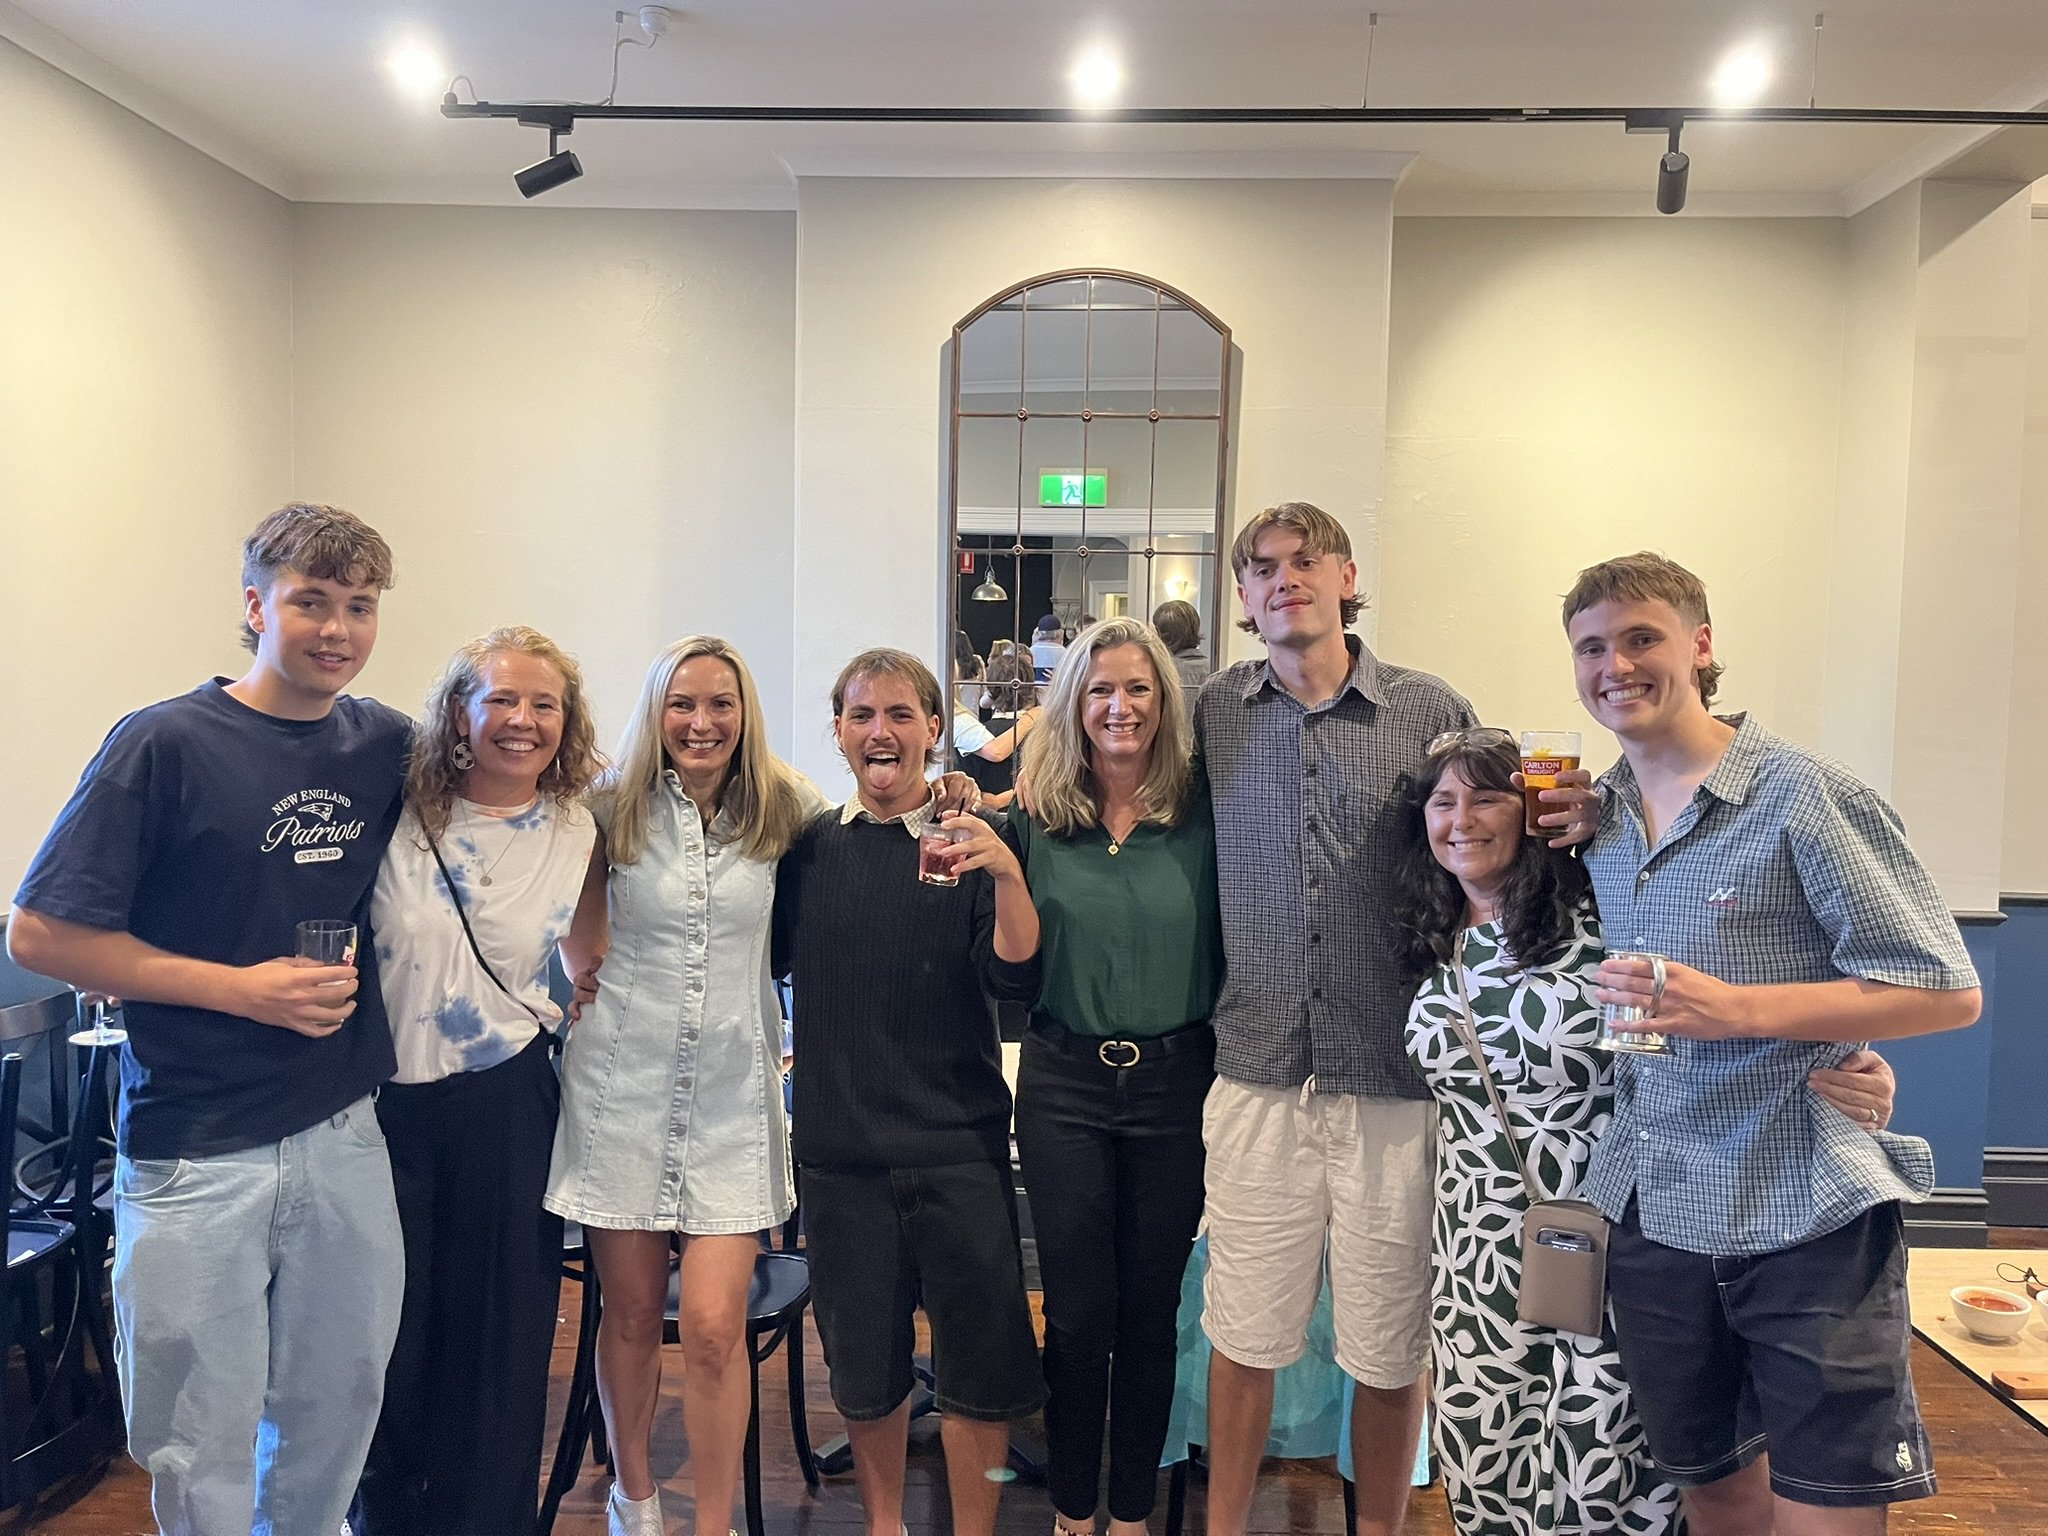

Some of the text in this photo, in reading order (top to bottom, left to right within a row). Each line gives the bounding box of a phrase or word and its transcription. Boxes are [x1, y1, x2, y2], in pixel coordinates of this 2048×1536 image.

[1524, 761, 1560, 769] CARLTON
[271, 789, 352, 816] NEW ENGLAND
[261, 815, 365, 852] Patriots
[318, 849, 339, 859] 1960
